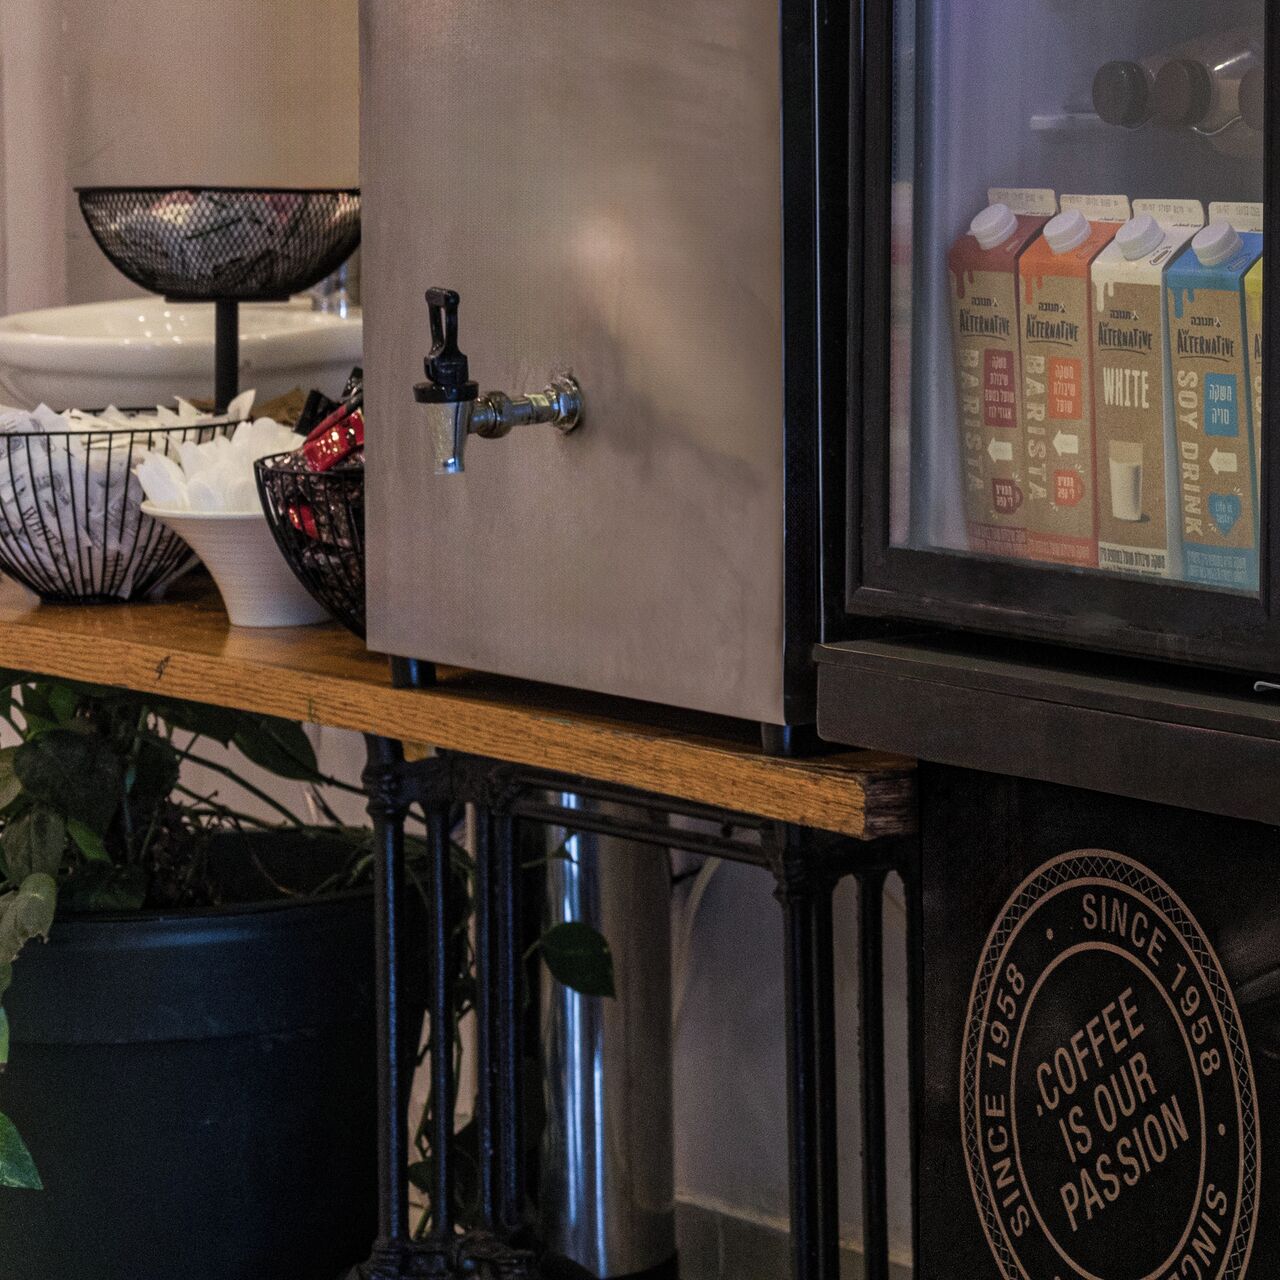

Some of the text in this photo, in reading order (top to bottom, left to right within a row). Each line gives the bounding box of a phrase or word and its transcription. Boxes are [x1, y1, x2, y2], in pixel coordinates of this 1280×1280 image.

[1025, 355, 1047, 500] BARISTA
[1103, 367, 1150, 409] WHITE
[1177, 370, 1203, 537] SOY DRINK
[1209, 384, 1232, 403] משקה
[1212, 408, 1230, 425] סויה
[1082, 893, 1220, 1076] SINCE 1958
[985, 963, 1030, 1237] SINCE 1958
[1059, 1051, 1158, 1163] IS OUR
[1059, 1095, 1190, 1232] PASSION
